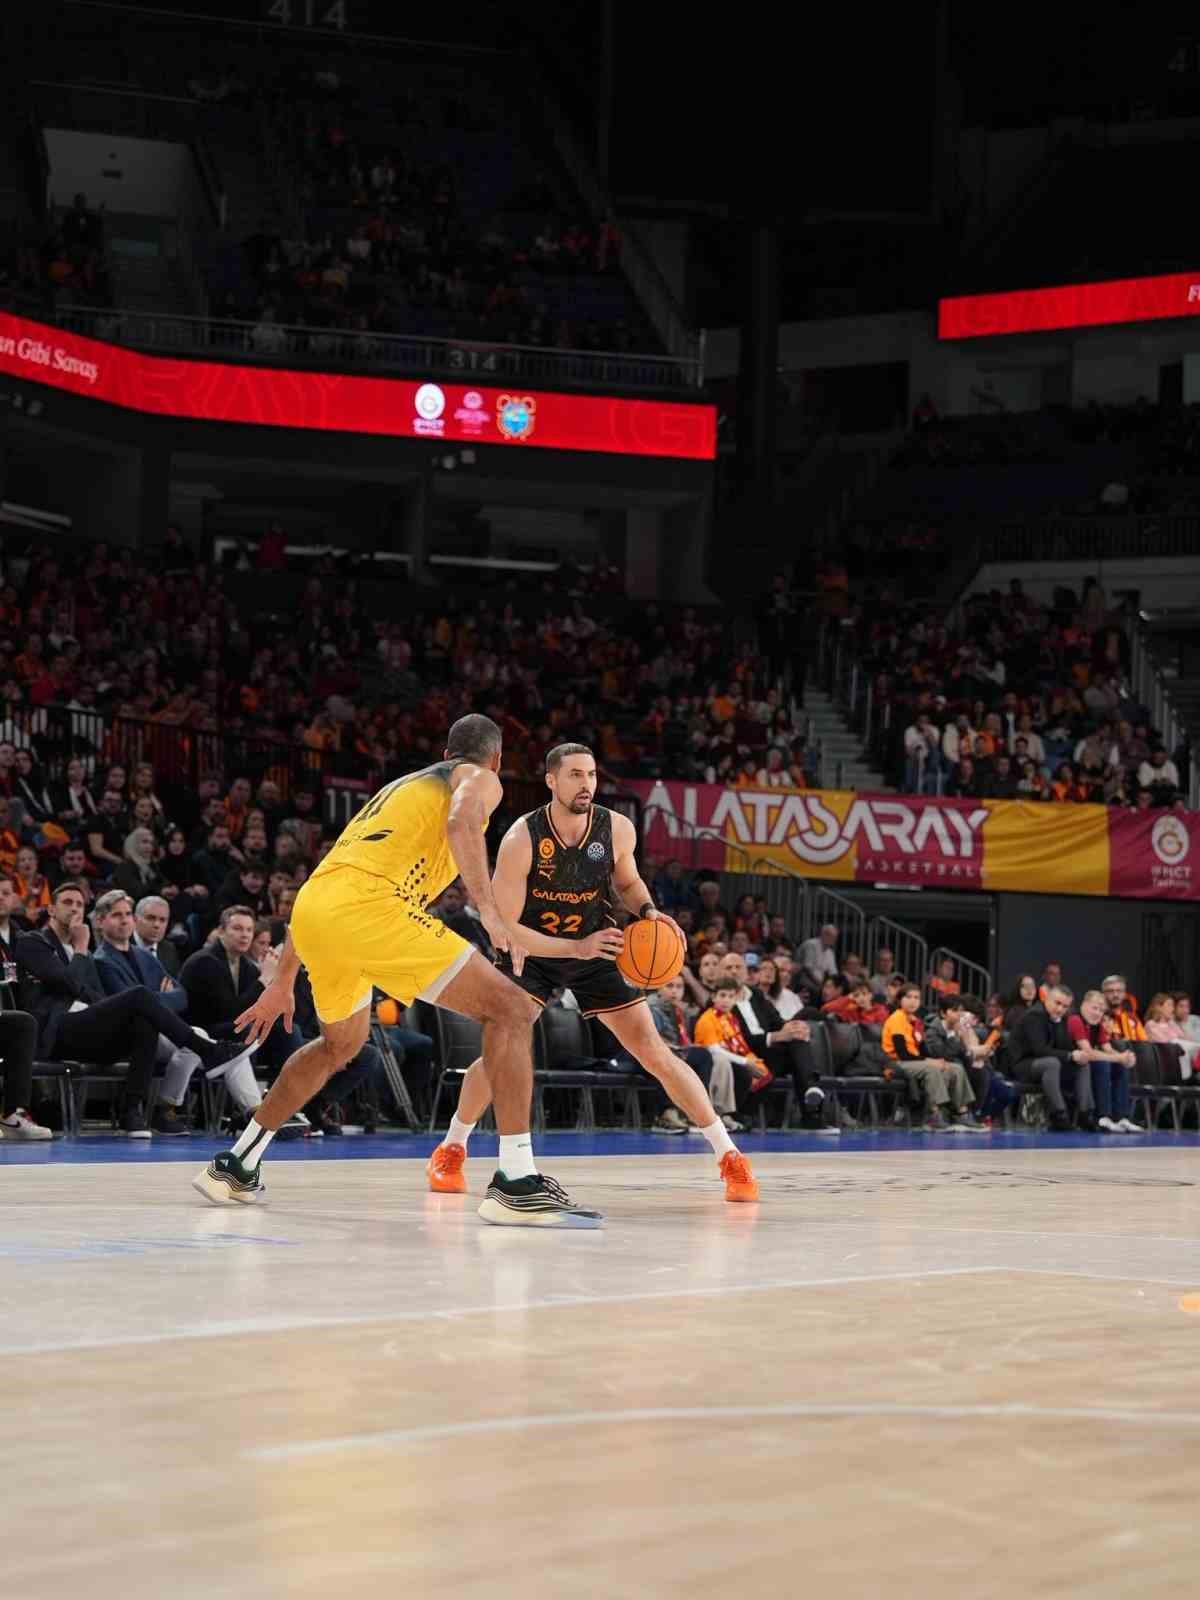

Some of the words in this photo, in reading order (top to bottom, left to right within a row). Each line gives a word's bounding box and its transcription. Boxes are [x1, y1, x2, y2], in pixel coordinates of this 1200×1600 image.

[266, 0, 348, 30] 414
[449, 349, 497, 371] 314
[642, 783, 990, 863] ALATASARAY
[540, 911, 583, 935] 22
